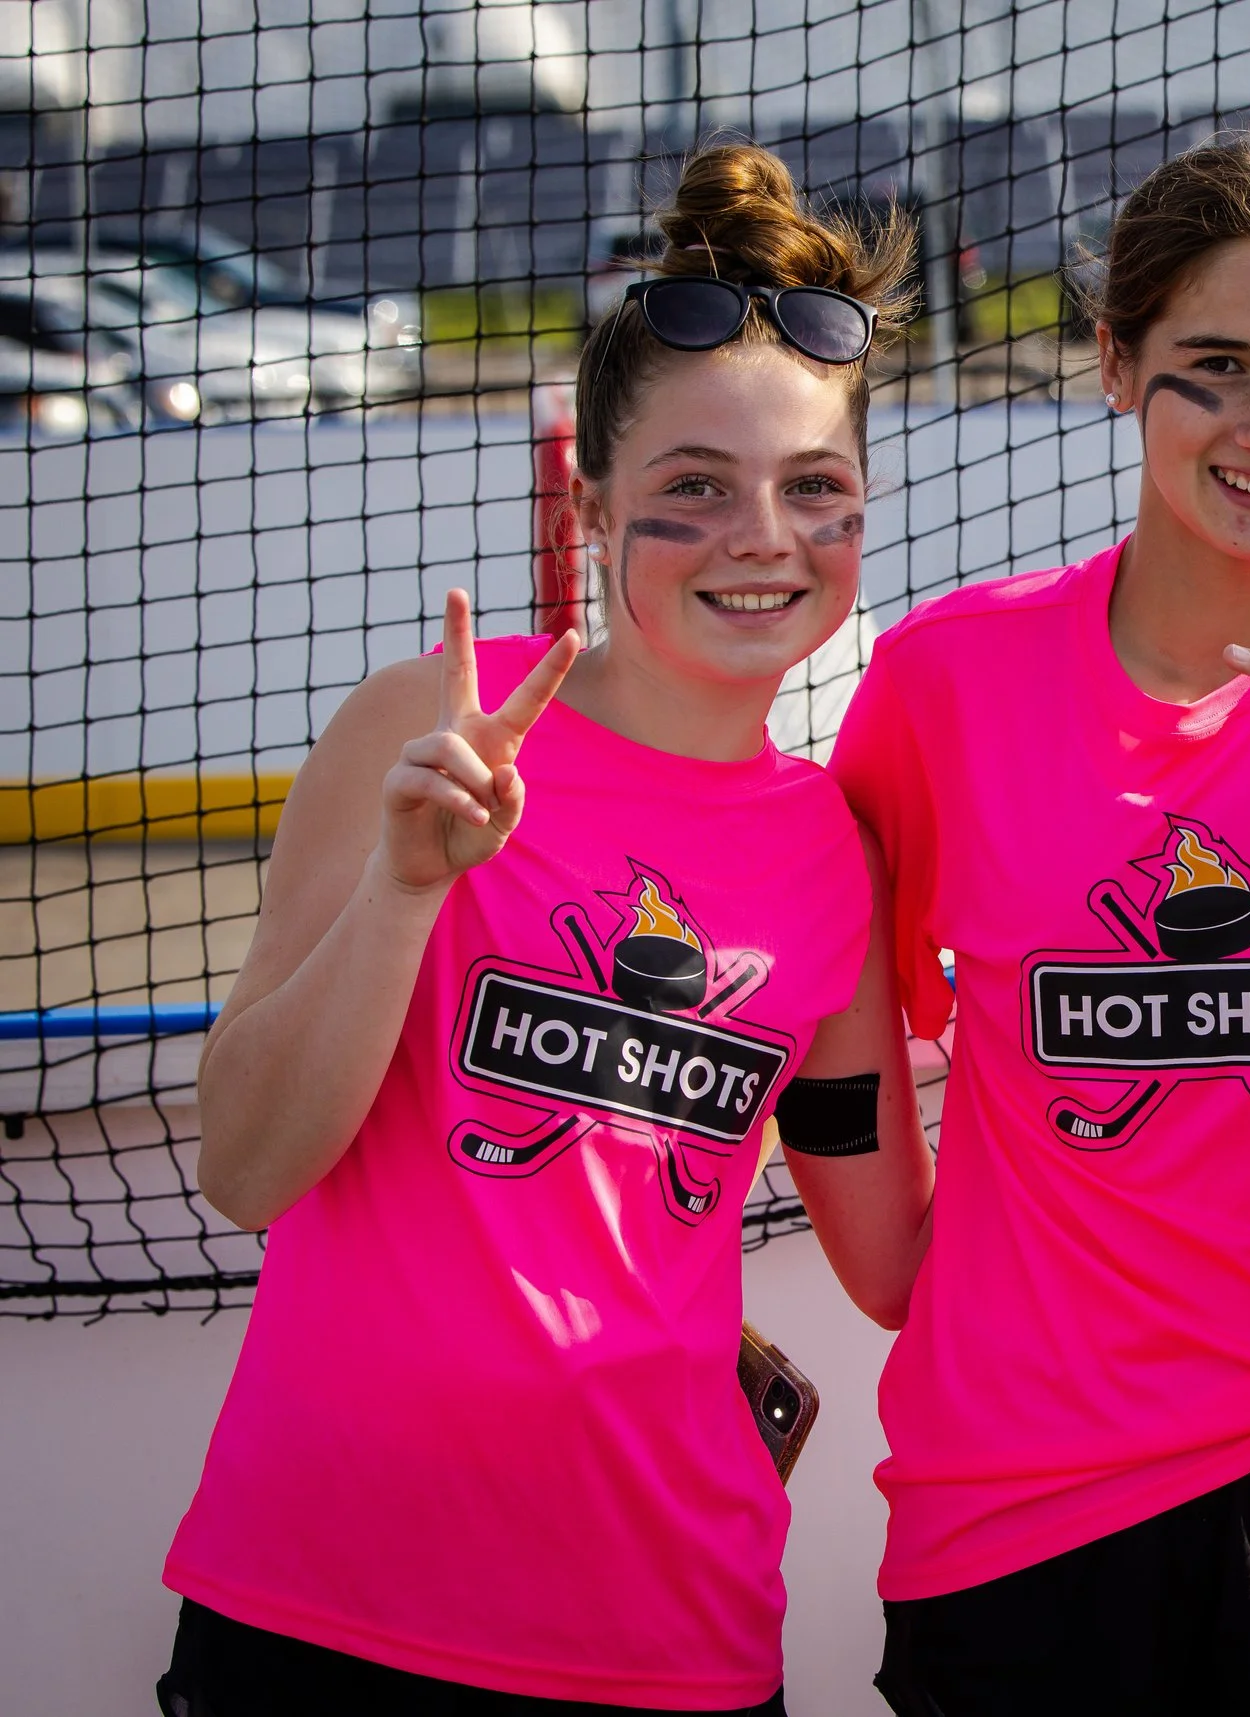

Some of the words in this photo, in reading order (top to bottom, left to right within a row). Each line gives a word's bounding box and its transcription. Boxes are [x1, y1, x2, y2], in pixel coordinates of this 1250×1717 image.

[1059, 994, 1169, 1038] HOT
[491, 1006, 608, 1073] HOT
[617, 1037, 759, 1114] SHOTS
